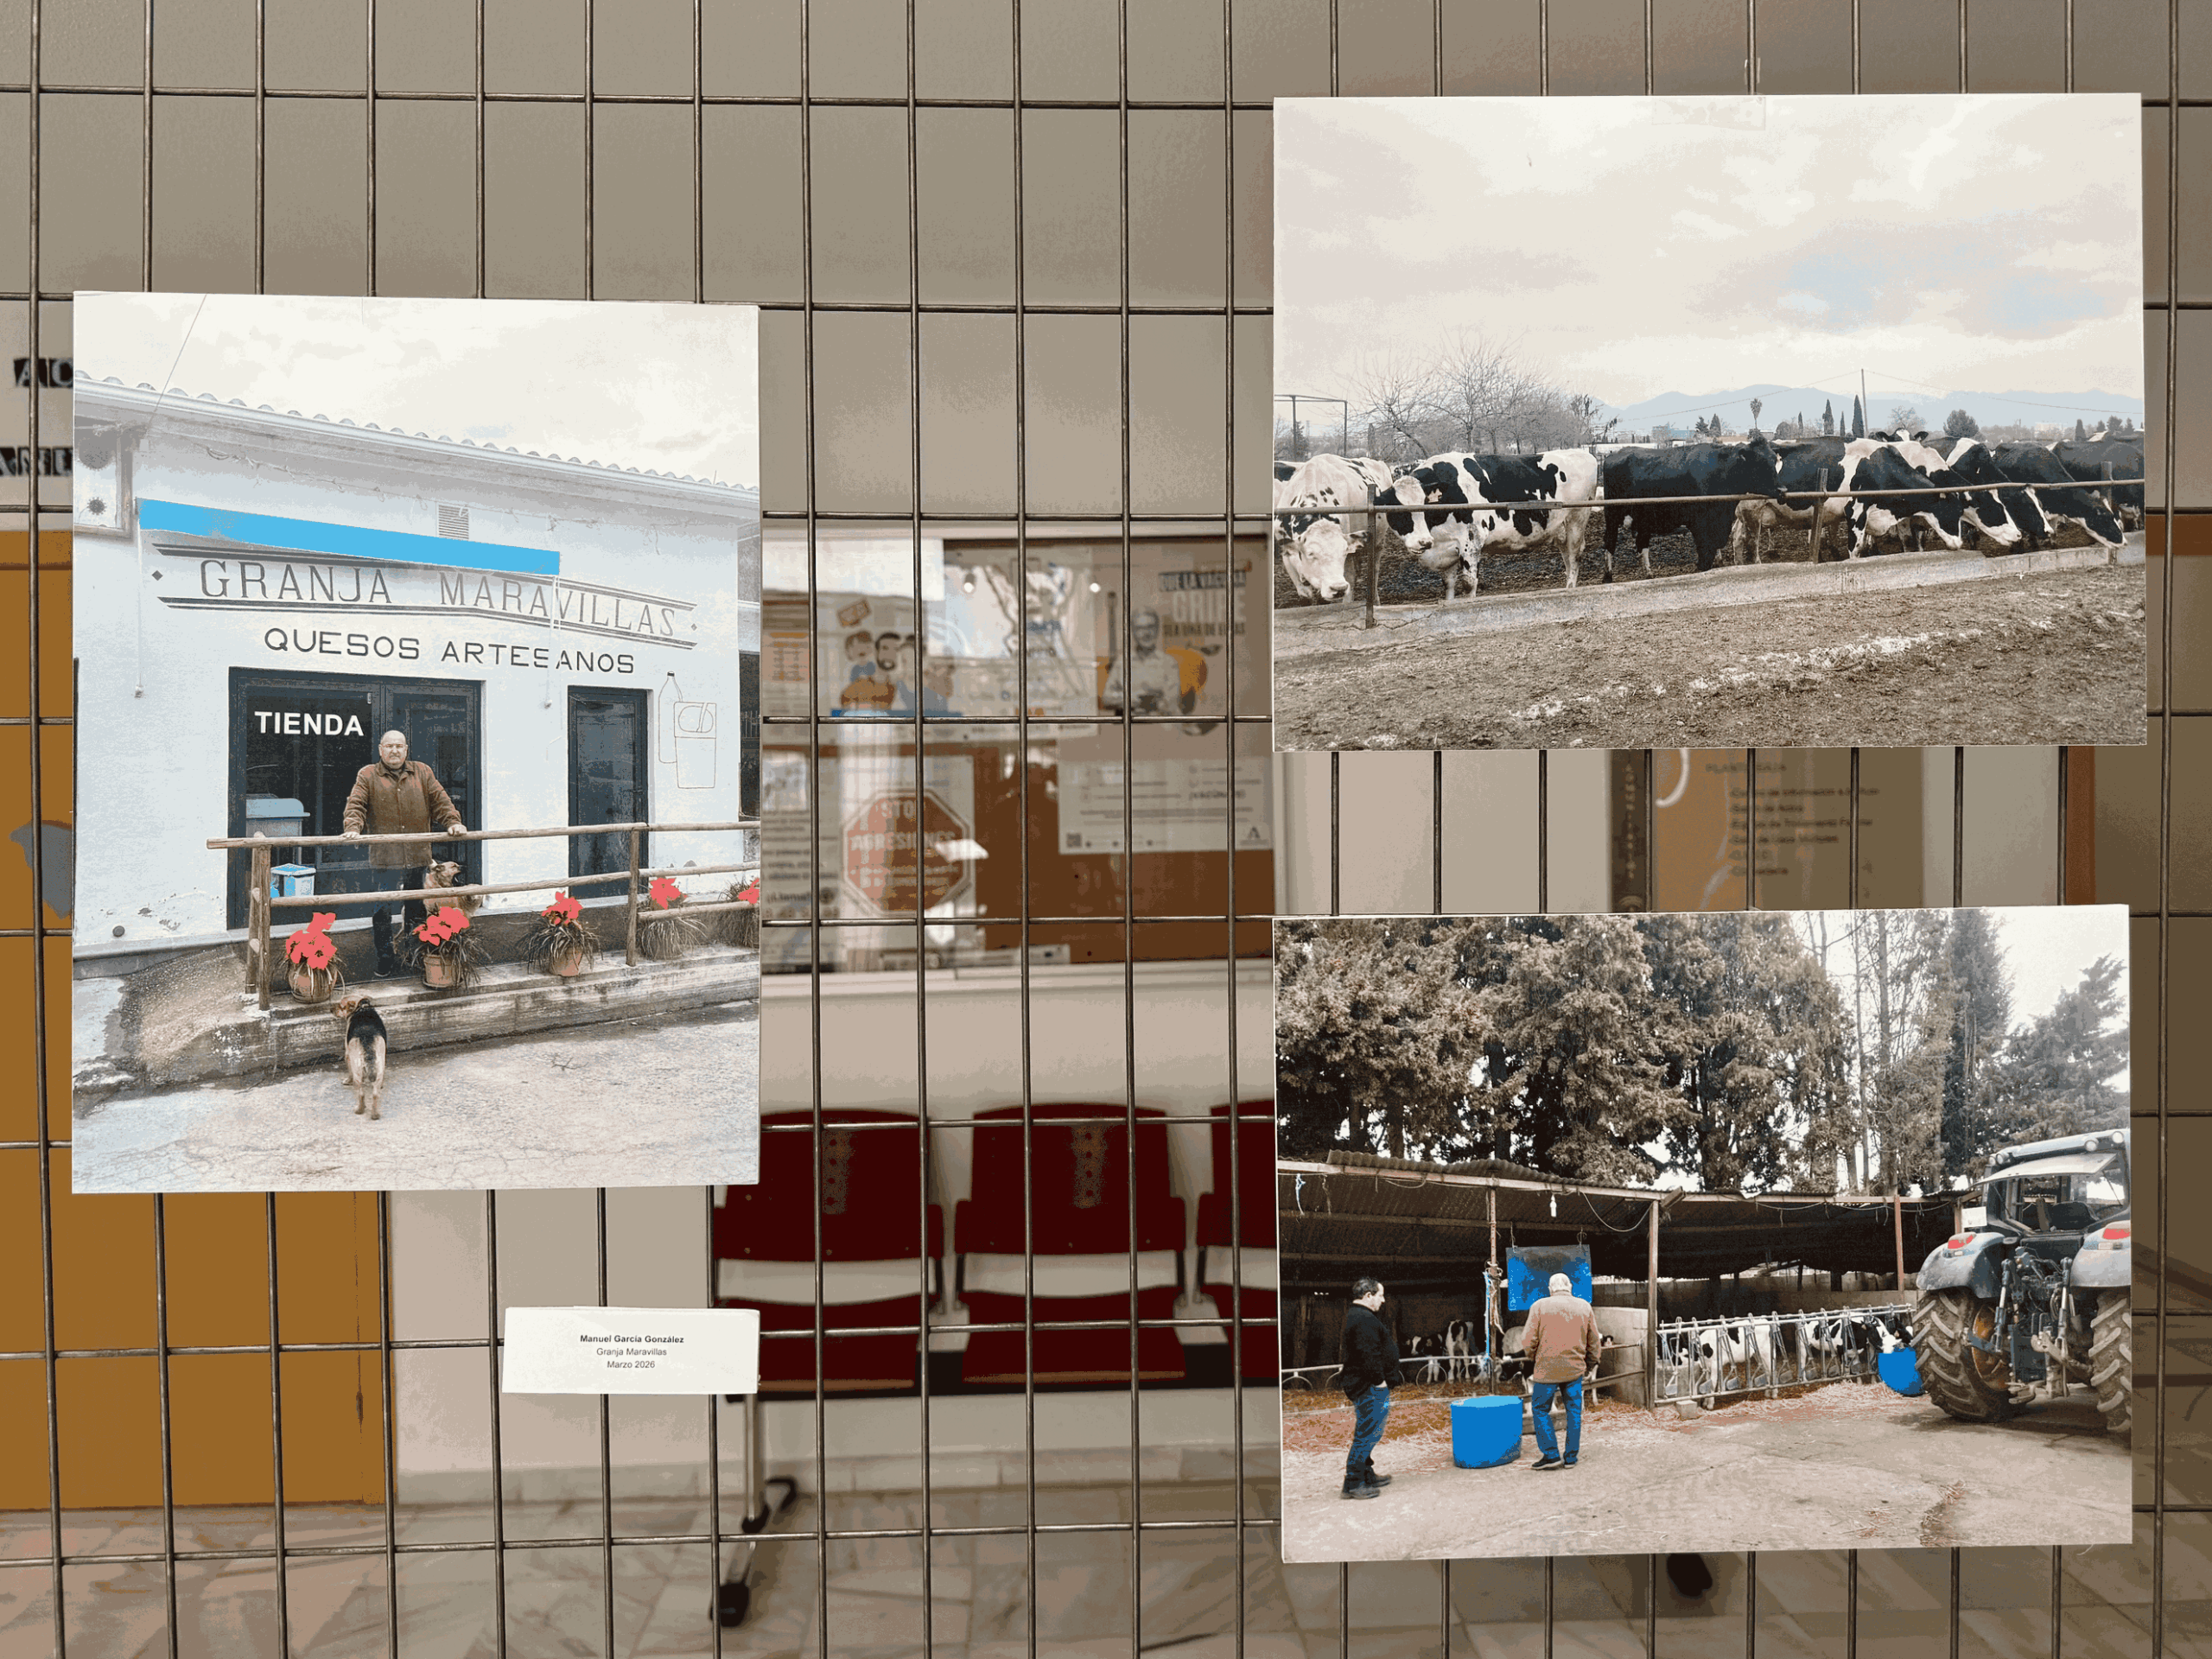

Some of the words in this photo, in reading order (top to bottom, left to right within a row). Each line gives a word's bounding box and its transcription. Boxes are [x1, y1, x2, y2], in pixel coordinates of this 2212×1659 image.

[200, 559, 392, 604] GRANJA
[439, 570, 675, 637] MARAVILLAS
[264, 627, 420, 660] QUESOS
[440, 640, 634, 674] ARTESANOS
[254, 710, 365, 737] TIENDA
[580, 1334, 612, 1343] Manuel
[614, 1334, 642, 1343] García
[645, 1335, 684, 1344] González
[596, 1348, 624, 1357] Granja
